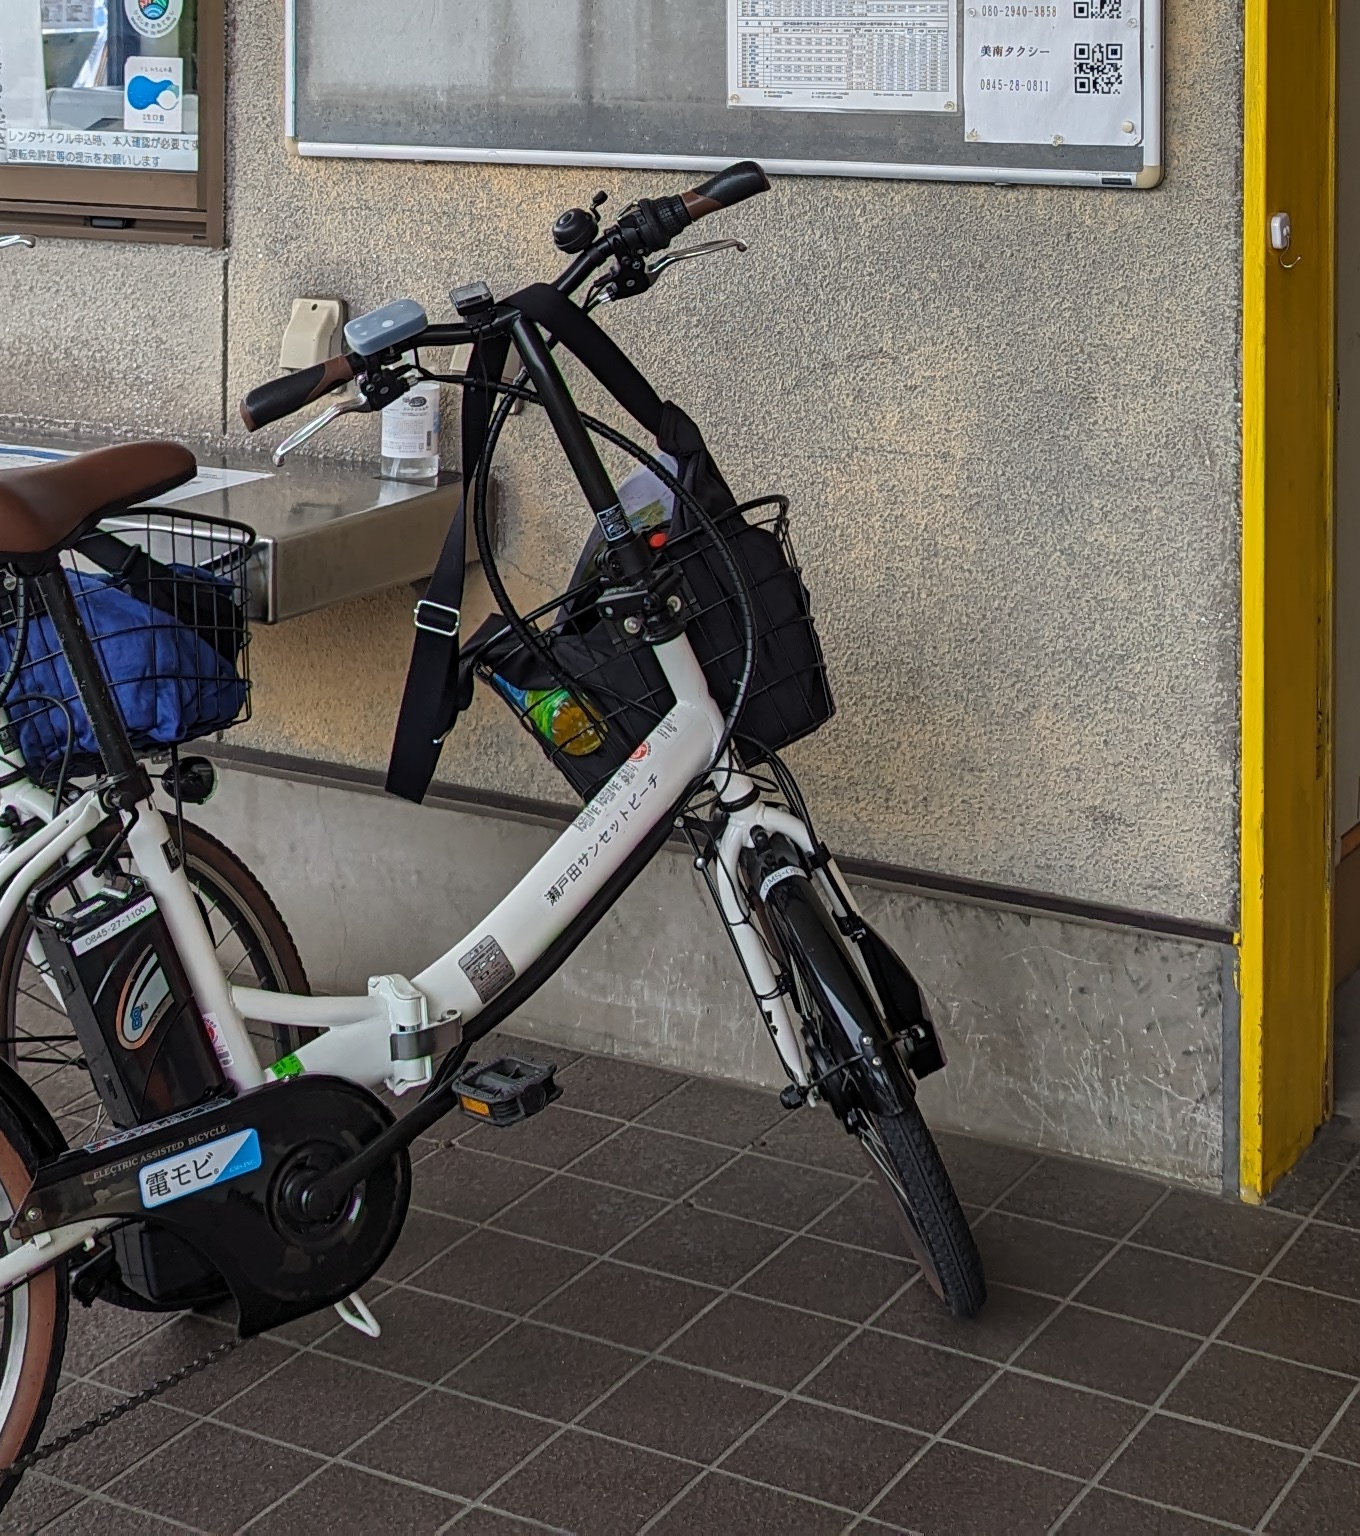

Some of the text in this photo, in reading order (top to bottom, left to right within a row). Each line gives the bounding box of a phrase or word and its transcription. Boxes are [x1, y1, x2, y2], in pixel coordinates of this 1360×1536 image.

[544, 773, 659, 906] 瀬戸田サンセットビーチ
[84, 905, 148, 946] 0845-27-1100
[93, 1124, 228, 1180] ELECTRIC ASSISTED BICYCLE
[145, 1151, 214, 1198] 電モビ
